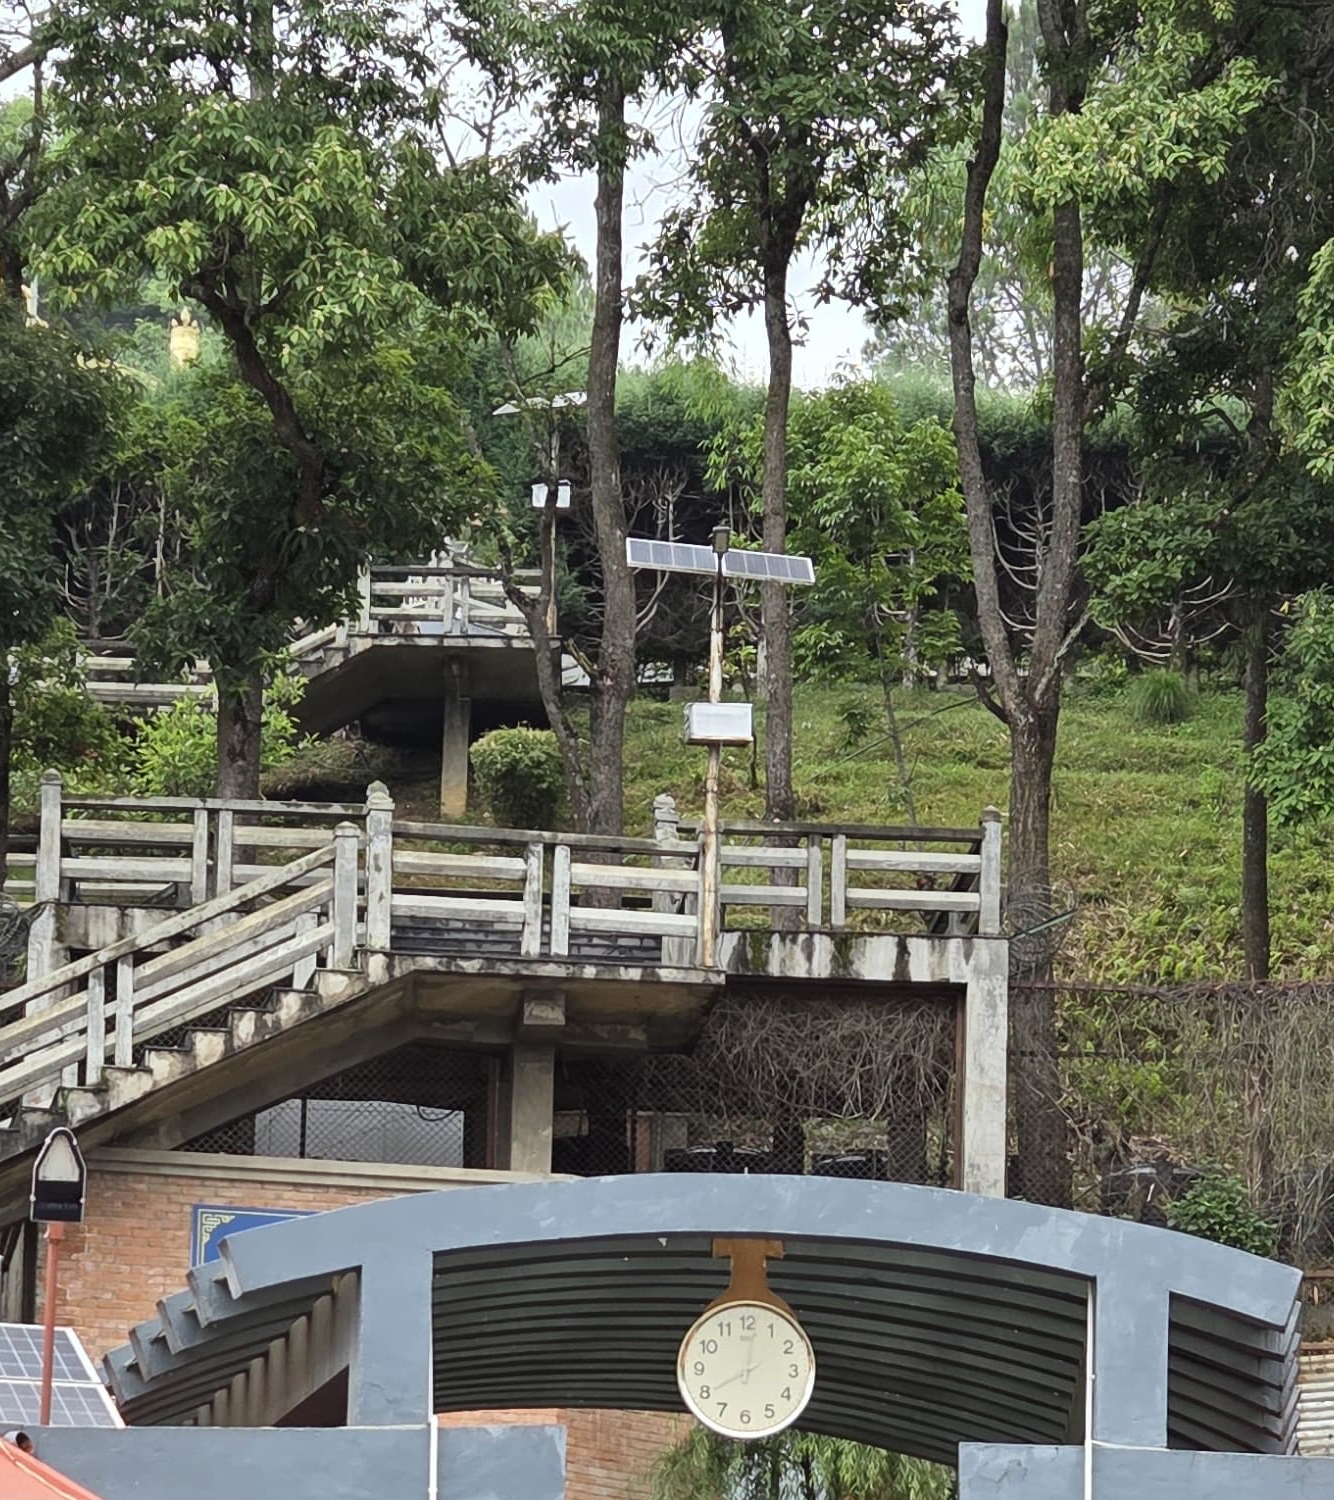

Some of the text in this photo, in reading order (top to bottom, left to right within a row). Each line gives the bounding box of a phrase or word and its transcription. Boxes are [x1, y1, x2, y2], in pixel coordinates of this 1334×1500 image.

[717, 1321, 732, 1337] 11
[739, 1315, 756, 1331] 12
[767, 1324, 774, 1338] 1
[699, 1339, 718, 1355] 10
[783, 1340, 794, 1355] 2
[694, 1361, 705, 1376] 9
[788, 1364, 799, 1378] 3
[699, 1385, 711, 1400] 8
[781, 1386, 791, 1401] 4
[717, 1402, 728, 1418] 7
[740, 1410, 751, 1424] 6
[764, 1404, 775, 1419] 5
